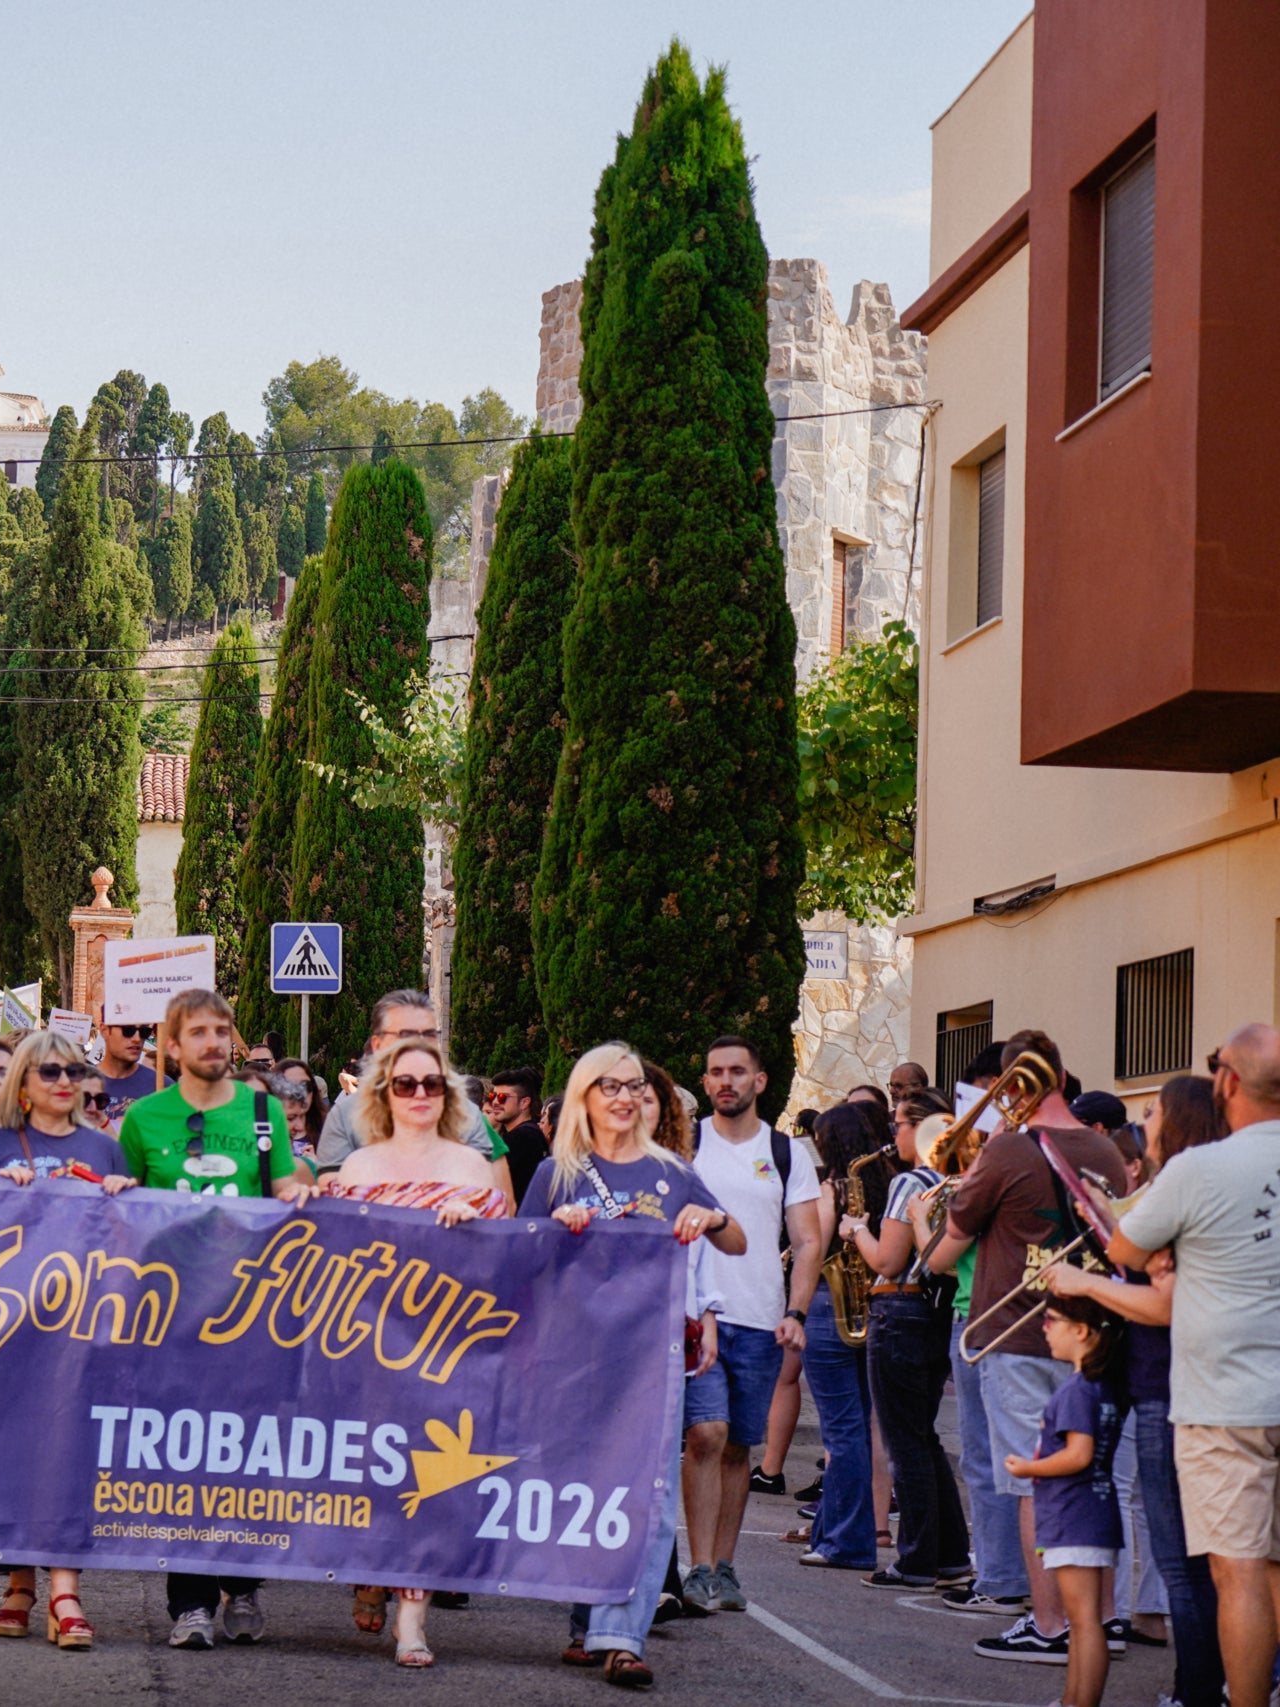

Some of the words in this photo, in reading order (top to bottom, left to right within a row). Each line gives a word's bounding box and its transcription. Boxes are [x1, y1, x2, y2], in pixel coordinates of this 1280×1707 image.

[805, 940, 834, 951] RRER
[806, 958, 837, 970] NDIA
[121, 977, 134, 985] IES
[165, 974, 193, 983] MARCH
[199, 1218, 521, 1386] futur
[90, 1404, 409, 1487] TROBADES
[200, 1484, 372, 1530] valenciana
[475, 1476, 632, 1551] 2026
[91, 1521, 291, 1551] activistespelvalencia.org
